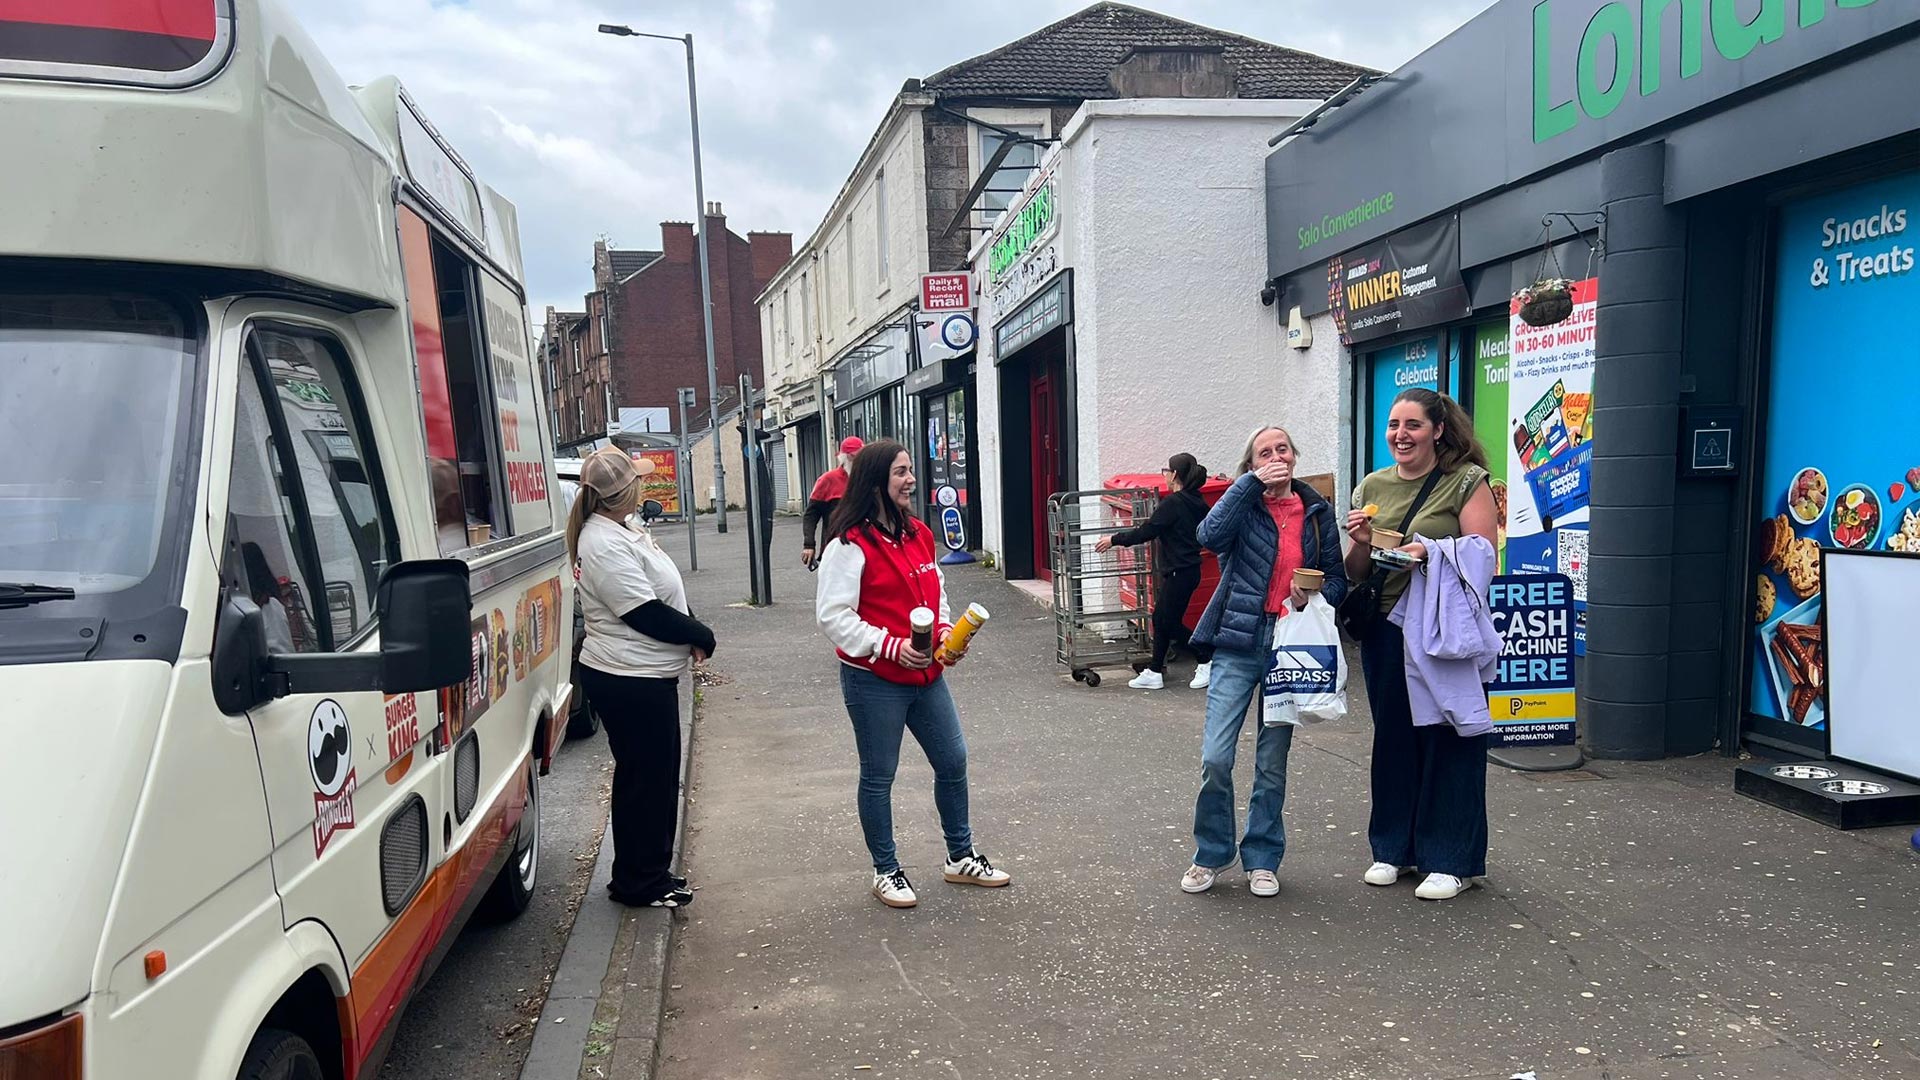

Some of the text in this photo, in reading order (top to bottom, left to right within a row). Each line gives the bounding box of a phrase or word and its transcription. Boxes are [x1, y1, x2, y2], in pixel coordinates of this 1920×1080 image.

[1299, 192, 1394, 249] Solo Convenience
[1821, 204, 1907, 248] Snacks
[1402, 263, 1428, 280] Customer
[1810, 245, 1915, 287] & Treats
[929, 278, 952, 286] Daily
[929, 284, 963, 292] Record
[1346, 270, 1402, 311] WINNER
[1402, 276, 1437, 297] Engagement
[930, 293, 964, 307] mail
[1405, 343, 1427, 361] Let's
[1515, 340, 1525, 354] IN
[1527, 334, 1554, 352] 30-60
[1517, 358, 1535, 368] Alcohol
[1539, 355, 1558, 365] Snacks
[1562, 350, 1580, 361] Crisps
[1527, 368, 1540, 378] Fizzy
[1541, 366, 1559, 375] Drinks
[1560, 363, 1571, 373] and
[1572, 361, 1589, 371] much
[492, 352, 519, 404] KING
[1394, 365, 1438, 387] Celebrate
[506, 461, 546, 504] PRINGLES
[1550, 470, 1574, 490] snappy
[1551, 478, 1580, 499] shopper
[945, 516, 958, 525] Play
[1489, 582, 1565, 607] FREE
[1491, 609, 1567, 638] CASH
[1266, 670, 1331, 685] TRESPASS
[1489, 657, 1568, 683] HERE
[385, 692, 417, 732] BURGER
[1524, 700, 1547, 708] PayPoint
[1503, 733, 1554, 741] INFORMATION
[1531, 724, 1546, 732] FOR
[1547, 723, 1569, 731] MORE
[388, 716, 419, 763] KING
[315, 781, 355, 850] PRINGLES
